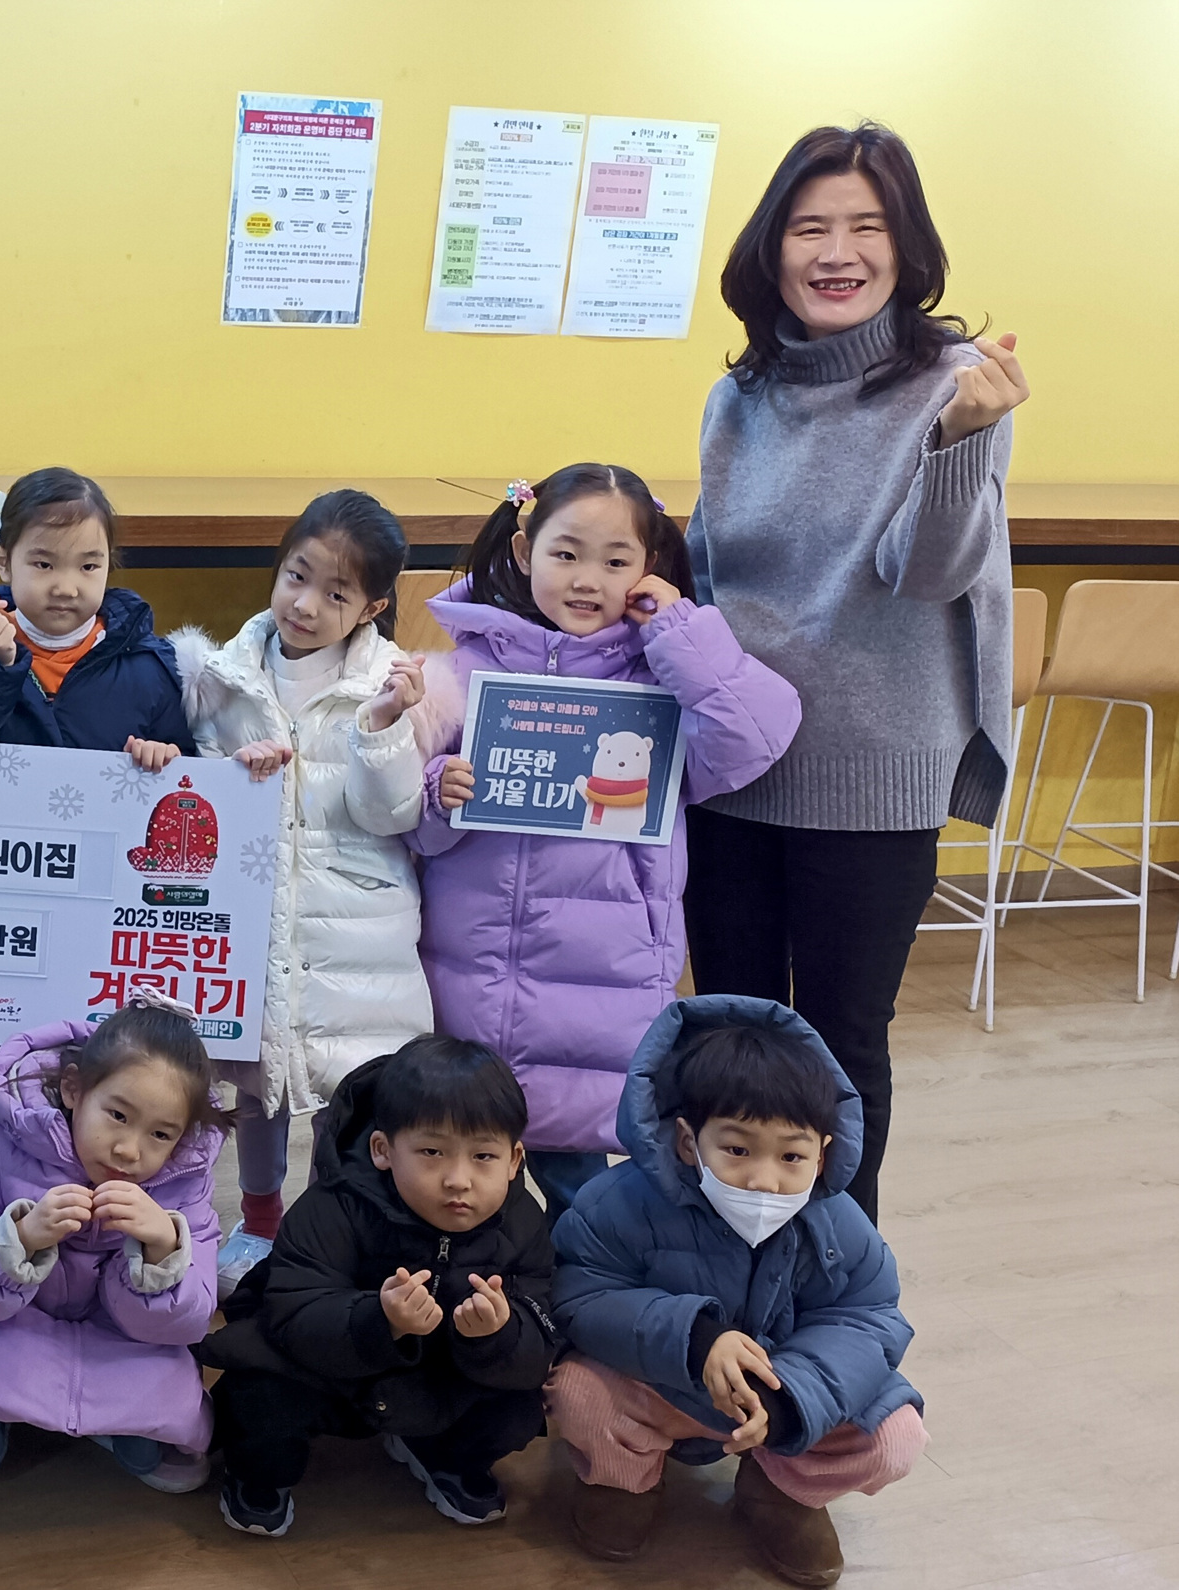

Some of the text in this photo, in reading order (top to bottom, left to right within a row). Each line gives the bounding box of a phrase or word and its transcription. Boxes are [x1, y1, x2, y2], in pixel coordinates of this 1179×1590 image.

[250, 122, 367, 138] 2분기 자치회관 운영비 중단 안내문
[507, 700, 598, 716] 우리들의 작은 마음을 모아
[511, 720, 587, 736] 사랑을 듬뿍 드립니다.
[487, 747, 557, 778] 따뜻한
[482, 777, 576, 811] 겨울 나기
[113, 907, 232, 934] 2025 희망온돌
[110, 930, 232, 974] 따뜻한
